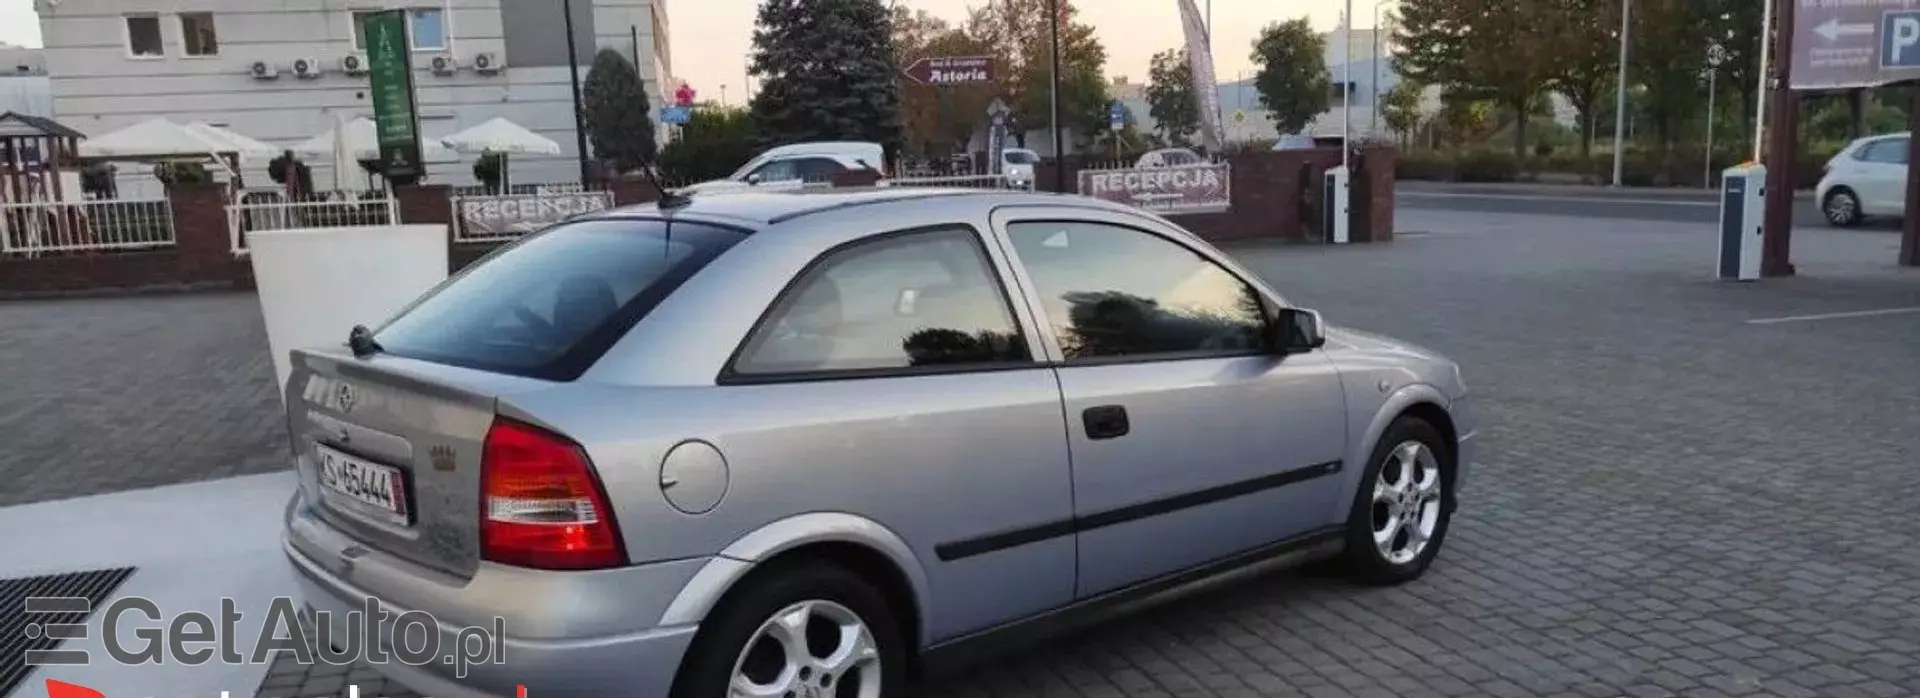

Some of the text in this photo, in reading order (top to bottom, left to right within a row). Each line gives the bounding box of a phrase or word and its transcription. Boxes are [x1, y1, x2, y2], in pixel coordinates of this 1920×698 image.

[1892, 17, 1920, 64] P
[929, 67, 987, 82] Astoria
[1093, 170, 1219, 193] RECEPCJA
